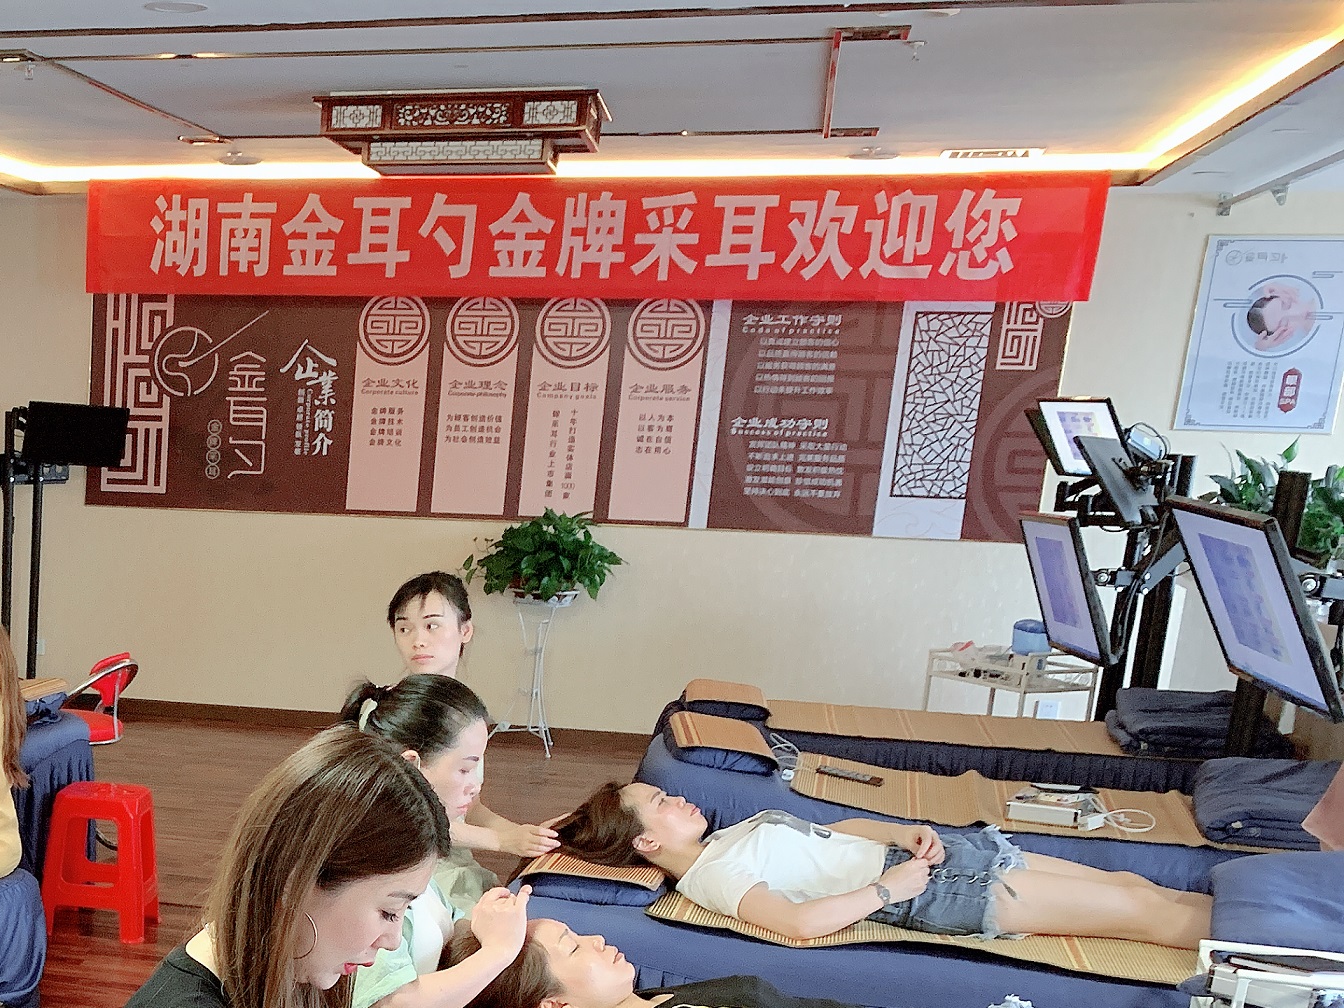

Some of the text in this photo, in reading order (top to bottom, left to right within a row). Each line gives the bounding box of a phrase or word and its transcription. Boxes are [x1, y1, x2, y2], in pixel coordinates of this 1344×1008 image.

[148, 189, 1023, 283] 湖南金耳勺金牌采耳欢迎您
[742, 314, 843, 326] 企业工作守则
[361, 377, 419, 389] 企业文化
[448, 379, 508, 391] 企业理念
[537, 380, 599, 392] 企业目标
[628, 383, 692, 395] 企业服务
[361, 388, 394, 396] Corporate
[628, 394, 664, 402] Corporate
[639, 413, 674, 422] 以人为本
[730, 417, 829, 430] 企业成功守则
[369, 438, 402, 447] 金牌文化
